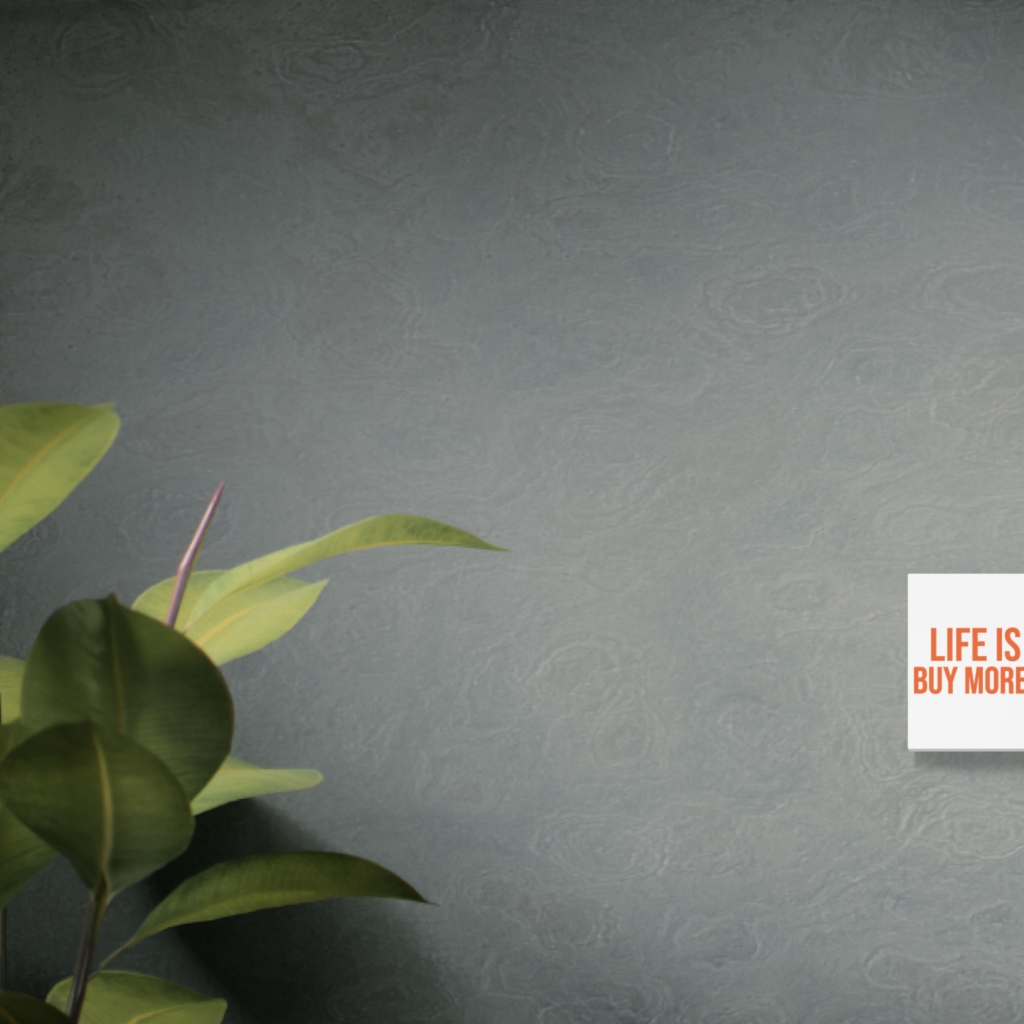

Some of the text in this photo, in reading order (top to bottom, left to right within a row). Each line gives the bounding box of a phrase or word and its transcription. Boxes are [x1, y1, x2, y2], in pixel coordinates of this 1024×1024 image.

[930, 627, 987, 662] LIFE
[996, 627, 1021, 662] IS
[913, 666, 958, 694] BUY
